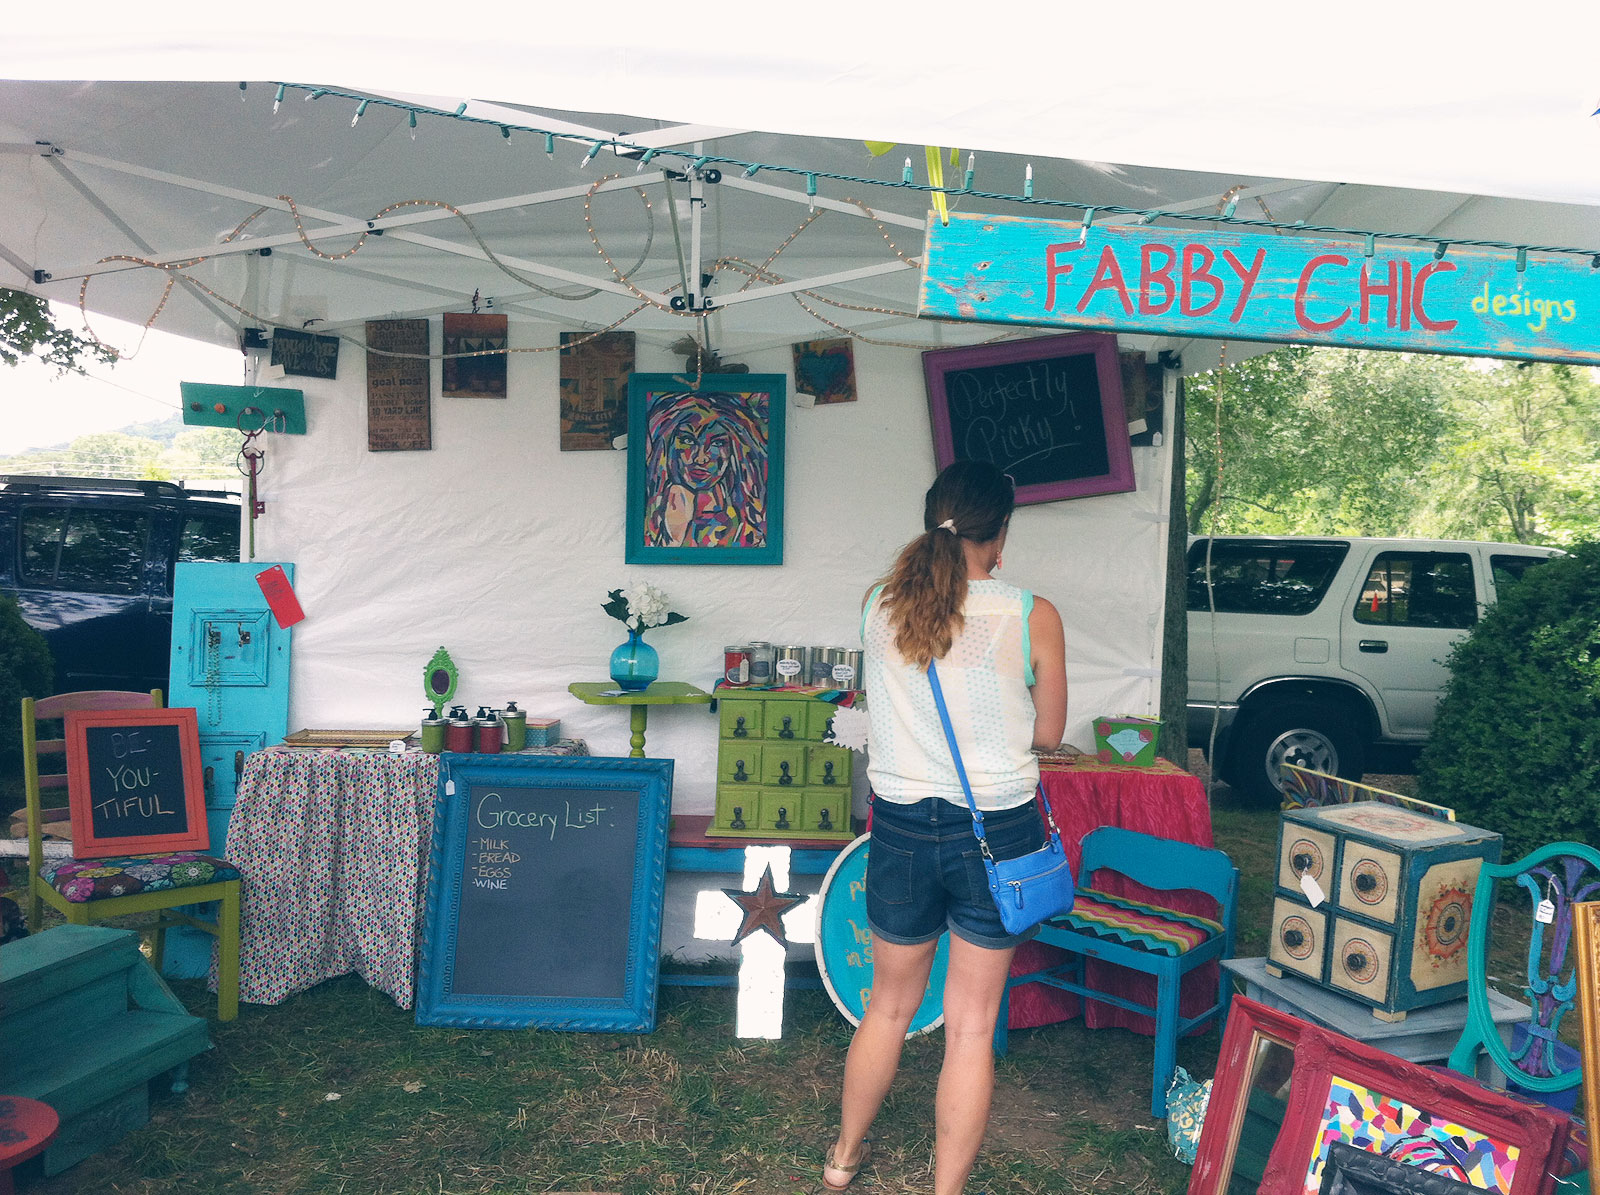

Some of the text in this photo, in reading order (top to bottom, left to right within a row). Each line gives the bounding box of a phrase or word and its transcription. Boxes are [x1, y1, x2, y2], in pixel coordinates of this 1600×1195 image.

[1043, 241, 1577, 333] FABBY CHIC designs
[372, 376, 424, 388] goal post
[952, 363, 1068, 422] Perfectly
[93, 794, 176, 820] TIFUL
[476, 792, 558, 841] Grocery
